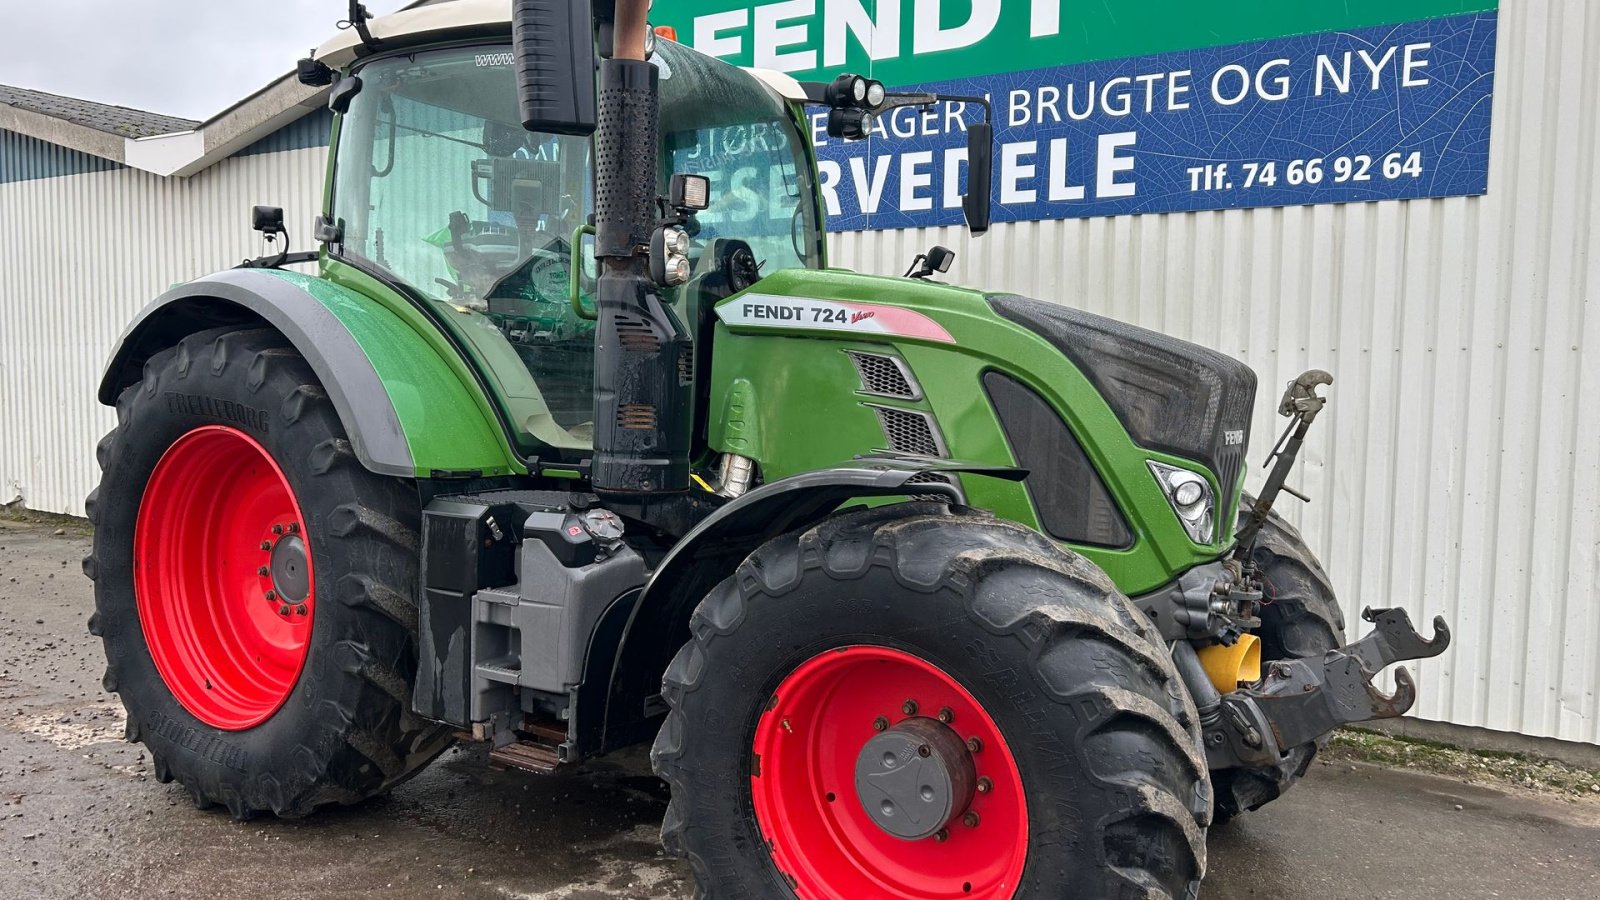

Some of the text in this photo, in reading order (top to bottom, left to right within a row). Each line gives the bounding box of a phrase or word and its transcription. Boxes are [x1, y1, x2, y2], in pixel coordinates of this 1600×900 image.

[843, 99, 968, 143] AGER
[1009, 69, 1192, 127] BRUGTE
[1211, 58, 1291, 106] OG
[1314, 42, 1431, 97] NYE
[1187, 163, 1232, 192] Tlf.
[1242, 162, 1277, 189] 74
[1286, 158, 1325, 186] 66
[1333, 154, 1372, 183] 92
[1382, 151, 1423, 180] 64
[743, 303, 804, 321] FENDT
[811, 307, 848, 324] 724
[164, 390, 270, 433] TRELLEBORG
